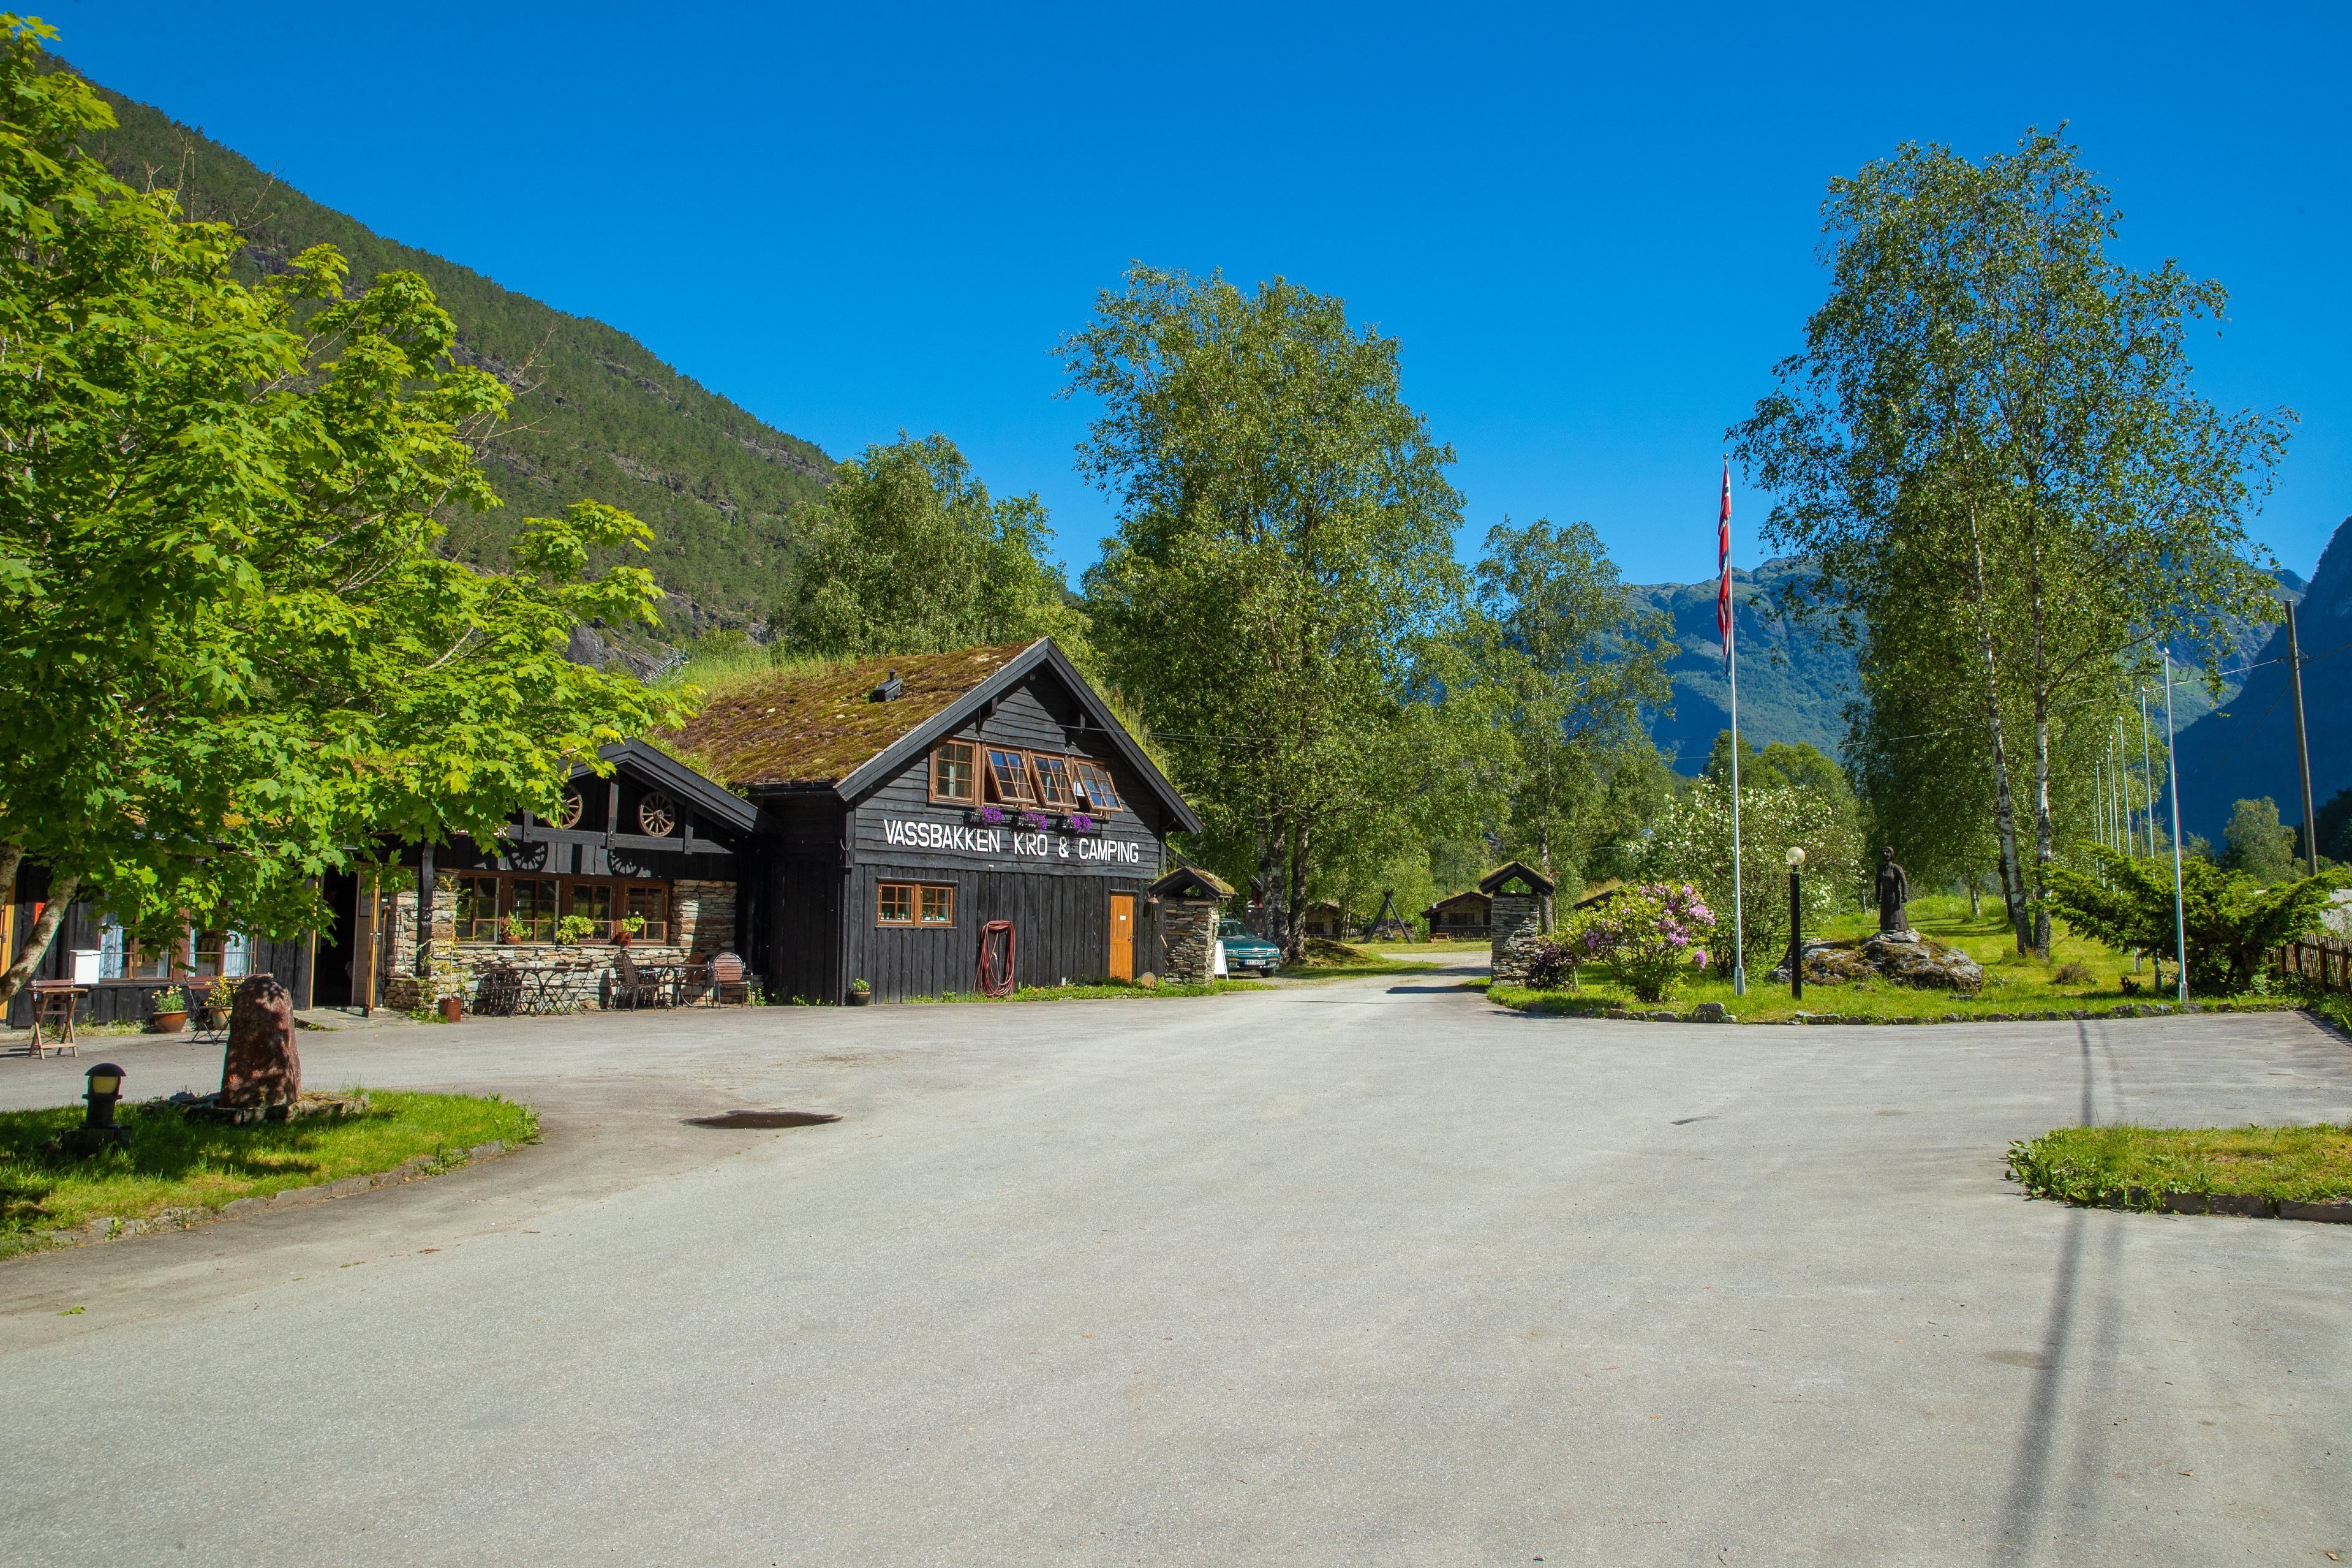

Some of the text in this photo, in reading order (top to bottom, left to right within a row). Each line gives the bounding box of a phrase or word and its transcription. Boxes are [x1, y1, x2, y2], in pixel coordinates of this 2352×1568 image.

[883, 819, 1139, 863] VASSBAKKEN KRO & CAMPING
